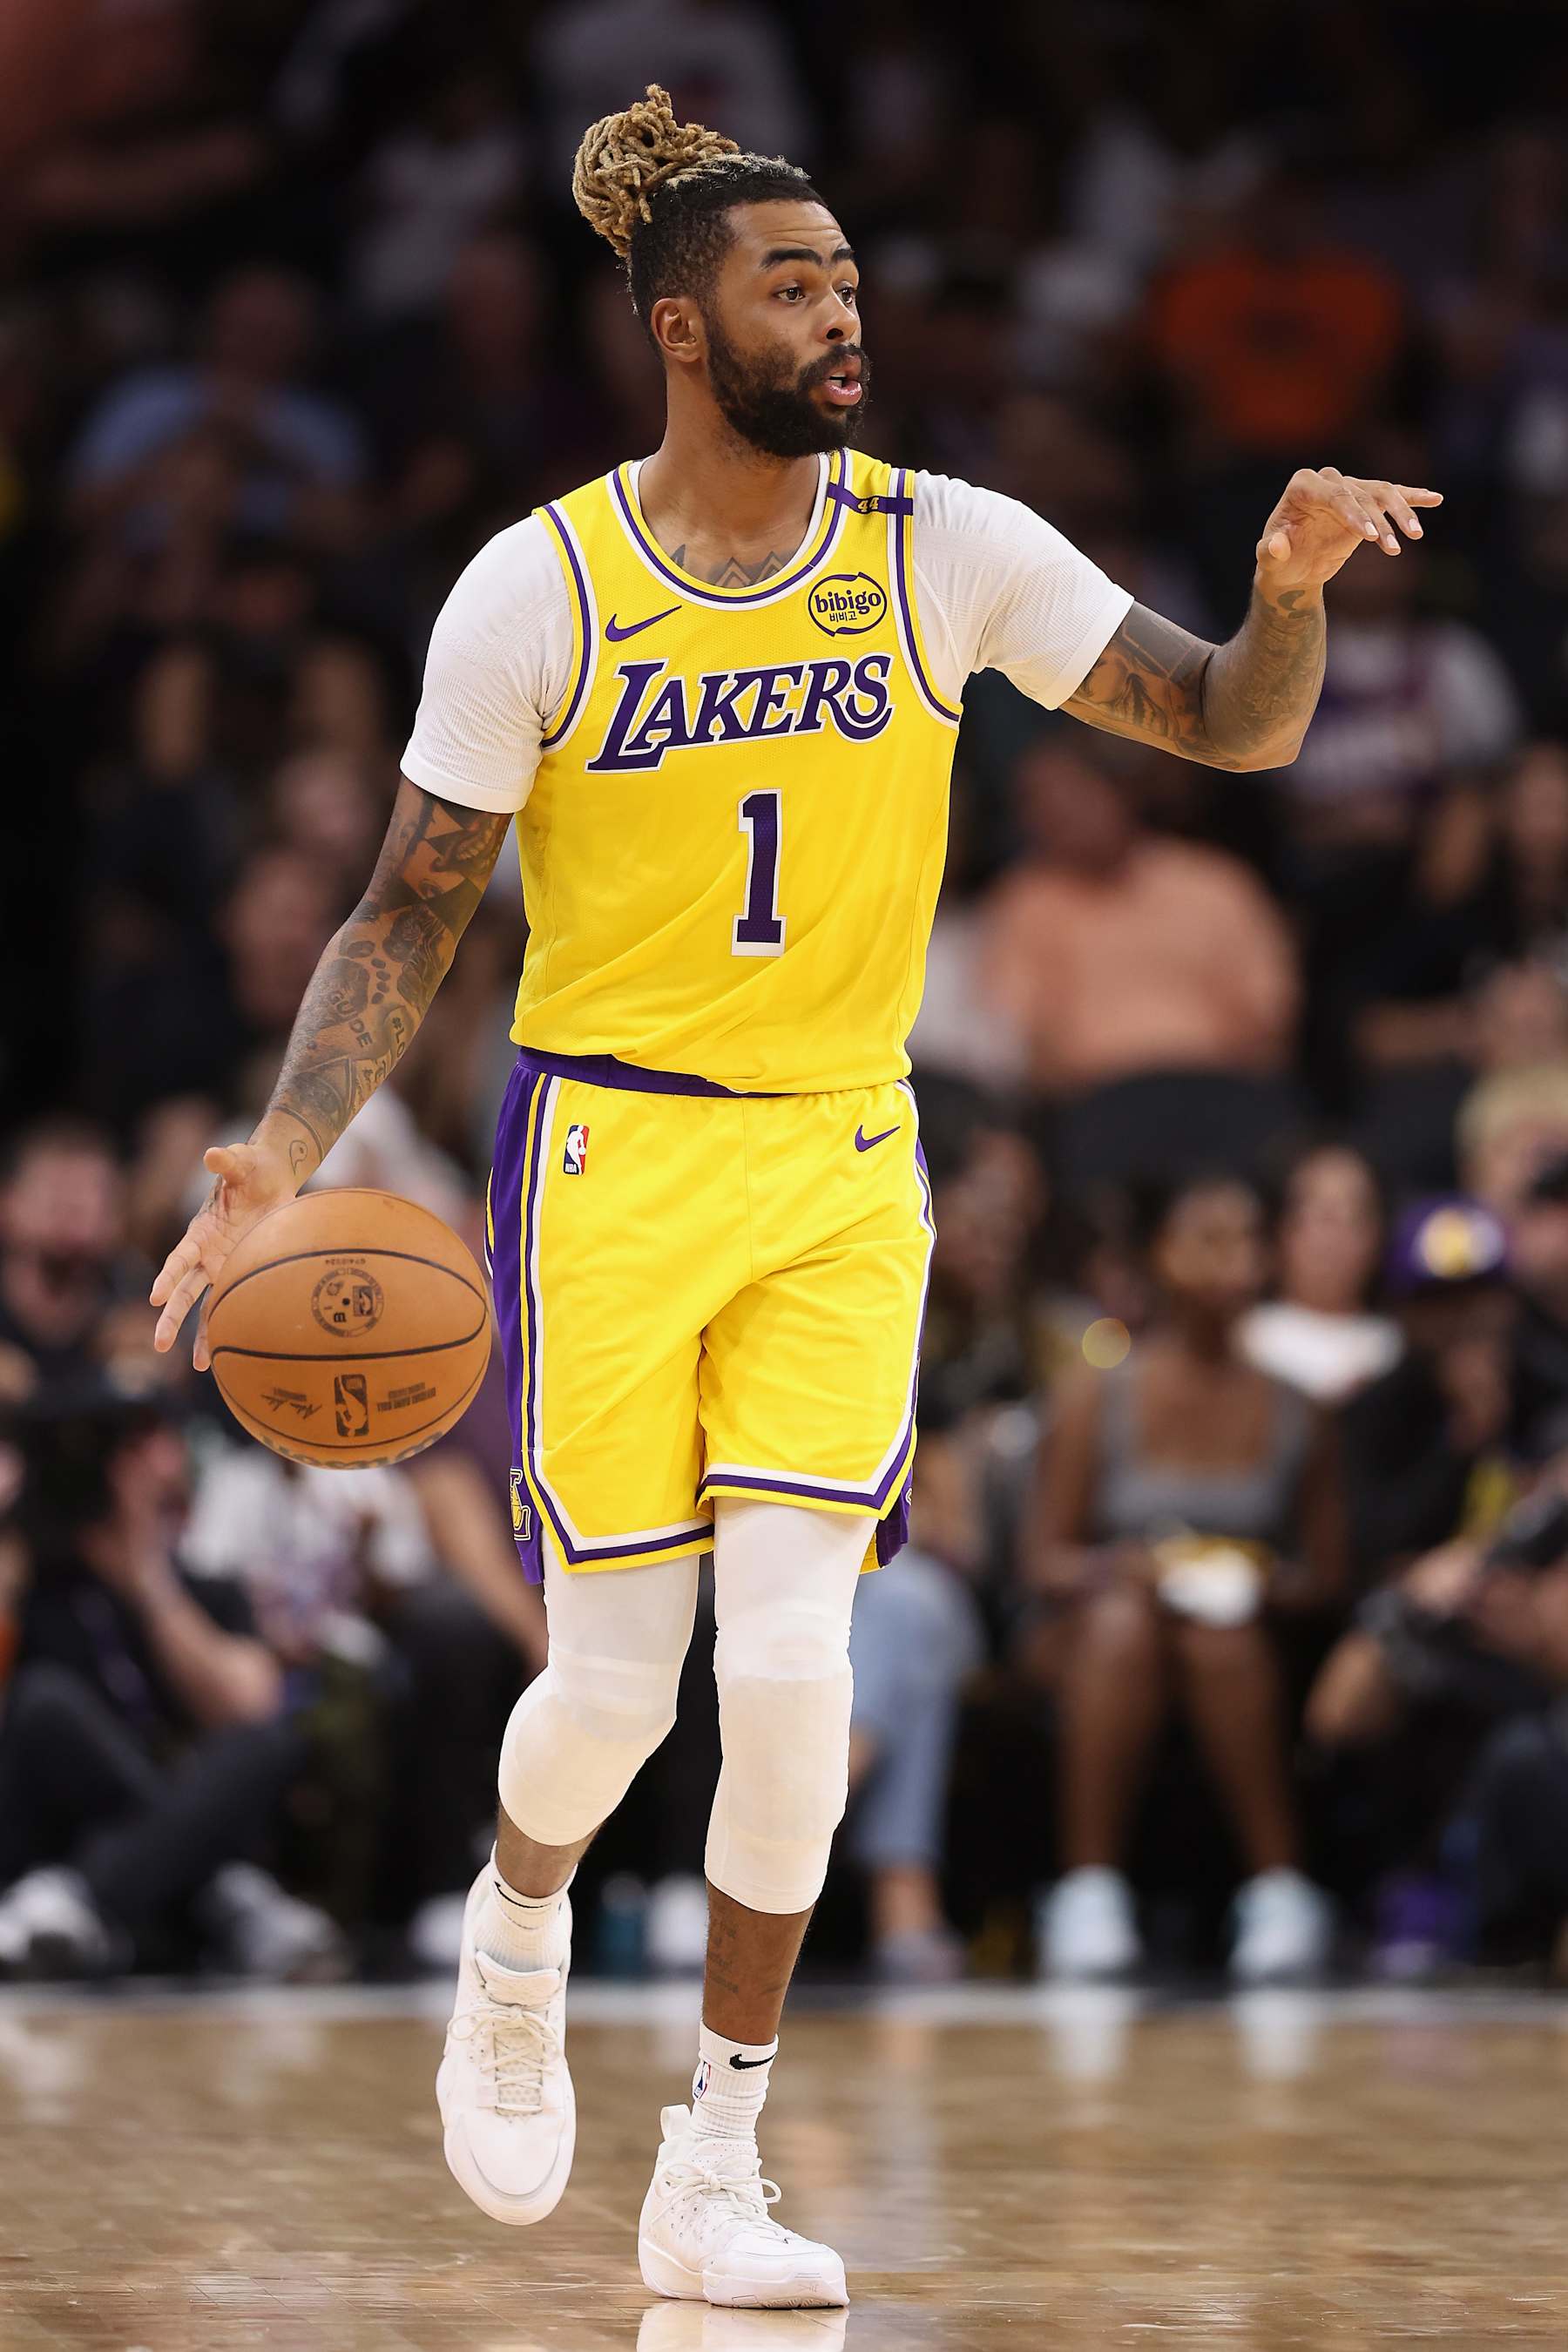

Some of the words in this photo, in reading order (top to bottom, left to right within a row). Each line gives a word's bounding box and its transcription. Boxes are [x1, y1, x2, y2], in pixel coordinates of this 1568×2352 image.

[857, 497, 879, 512] 44
[814, 590, 882, 614] bibigo
[829, 612, 857, 622] 비비고
[585, 652, 896, 773] LAKERS
[733, 789, 787, 956] 1
